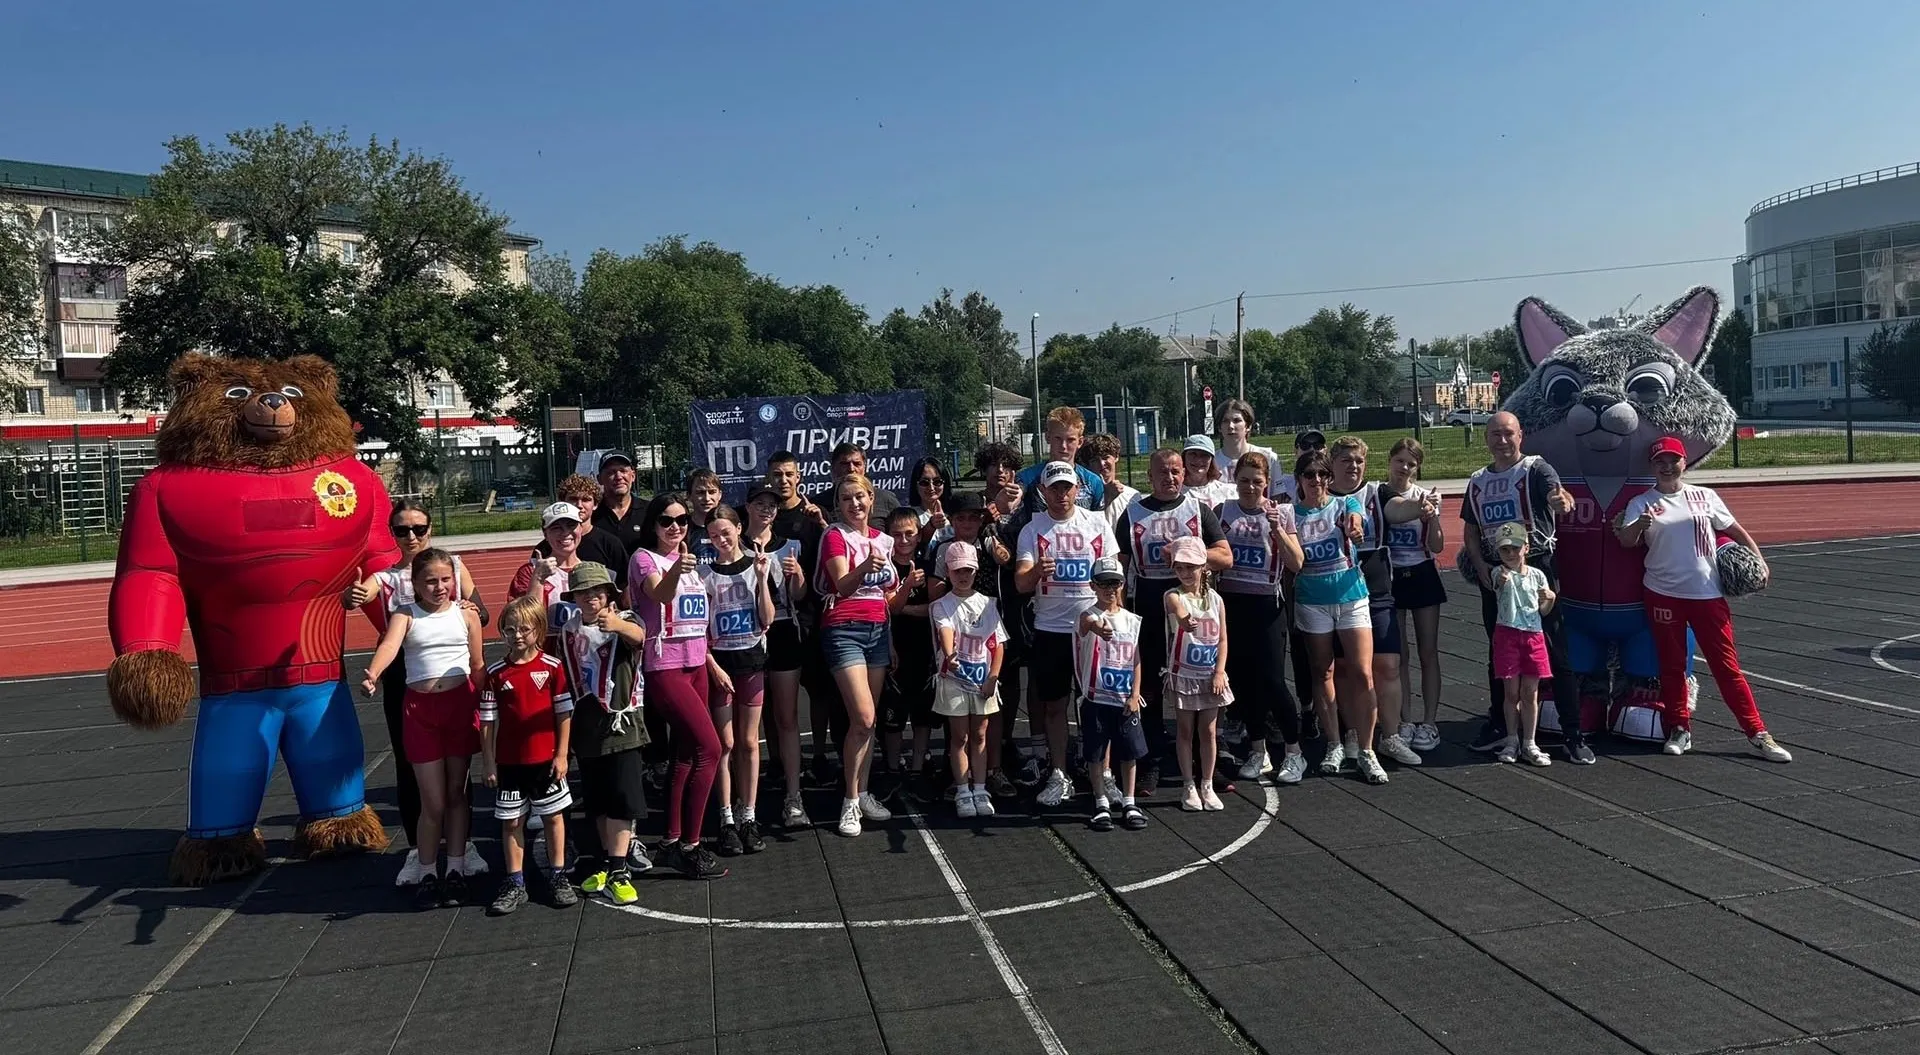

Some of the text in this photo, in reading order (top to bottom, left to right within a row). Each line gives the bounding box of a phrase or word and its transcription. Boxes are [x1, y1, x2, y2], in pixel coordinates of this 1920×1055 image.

[705, 411, 731, 419] СПОРТ
[706, 417, 745, 425] ТОЛЬЯТТИ
[785, 424, 908, 454] ПРИВЕТ
[707, 440, 757, 473] ГТО
[1485, 502, 1513, 519] 001
[1056, 533, 1084, 551] ГТО
[1305, 542, 1335, 559] 009
[1233, 547, 1262, 564] 013
[1056, 562, 1086, 578] 005
[683, 598, 705, 615] 025
[1653, 607, 1673, 619] ГТО
[720, 613, 754, 632] 024
